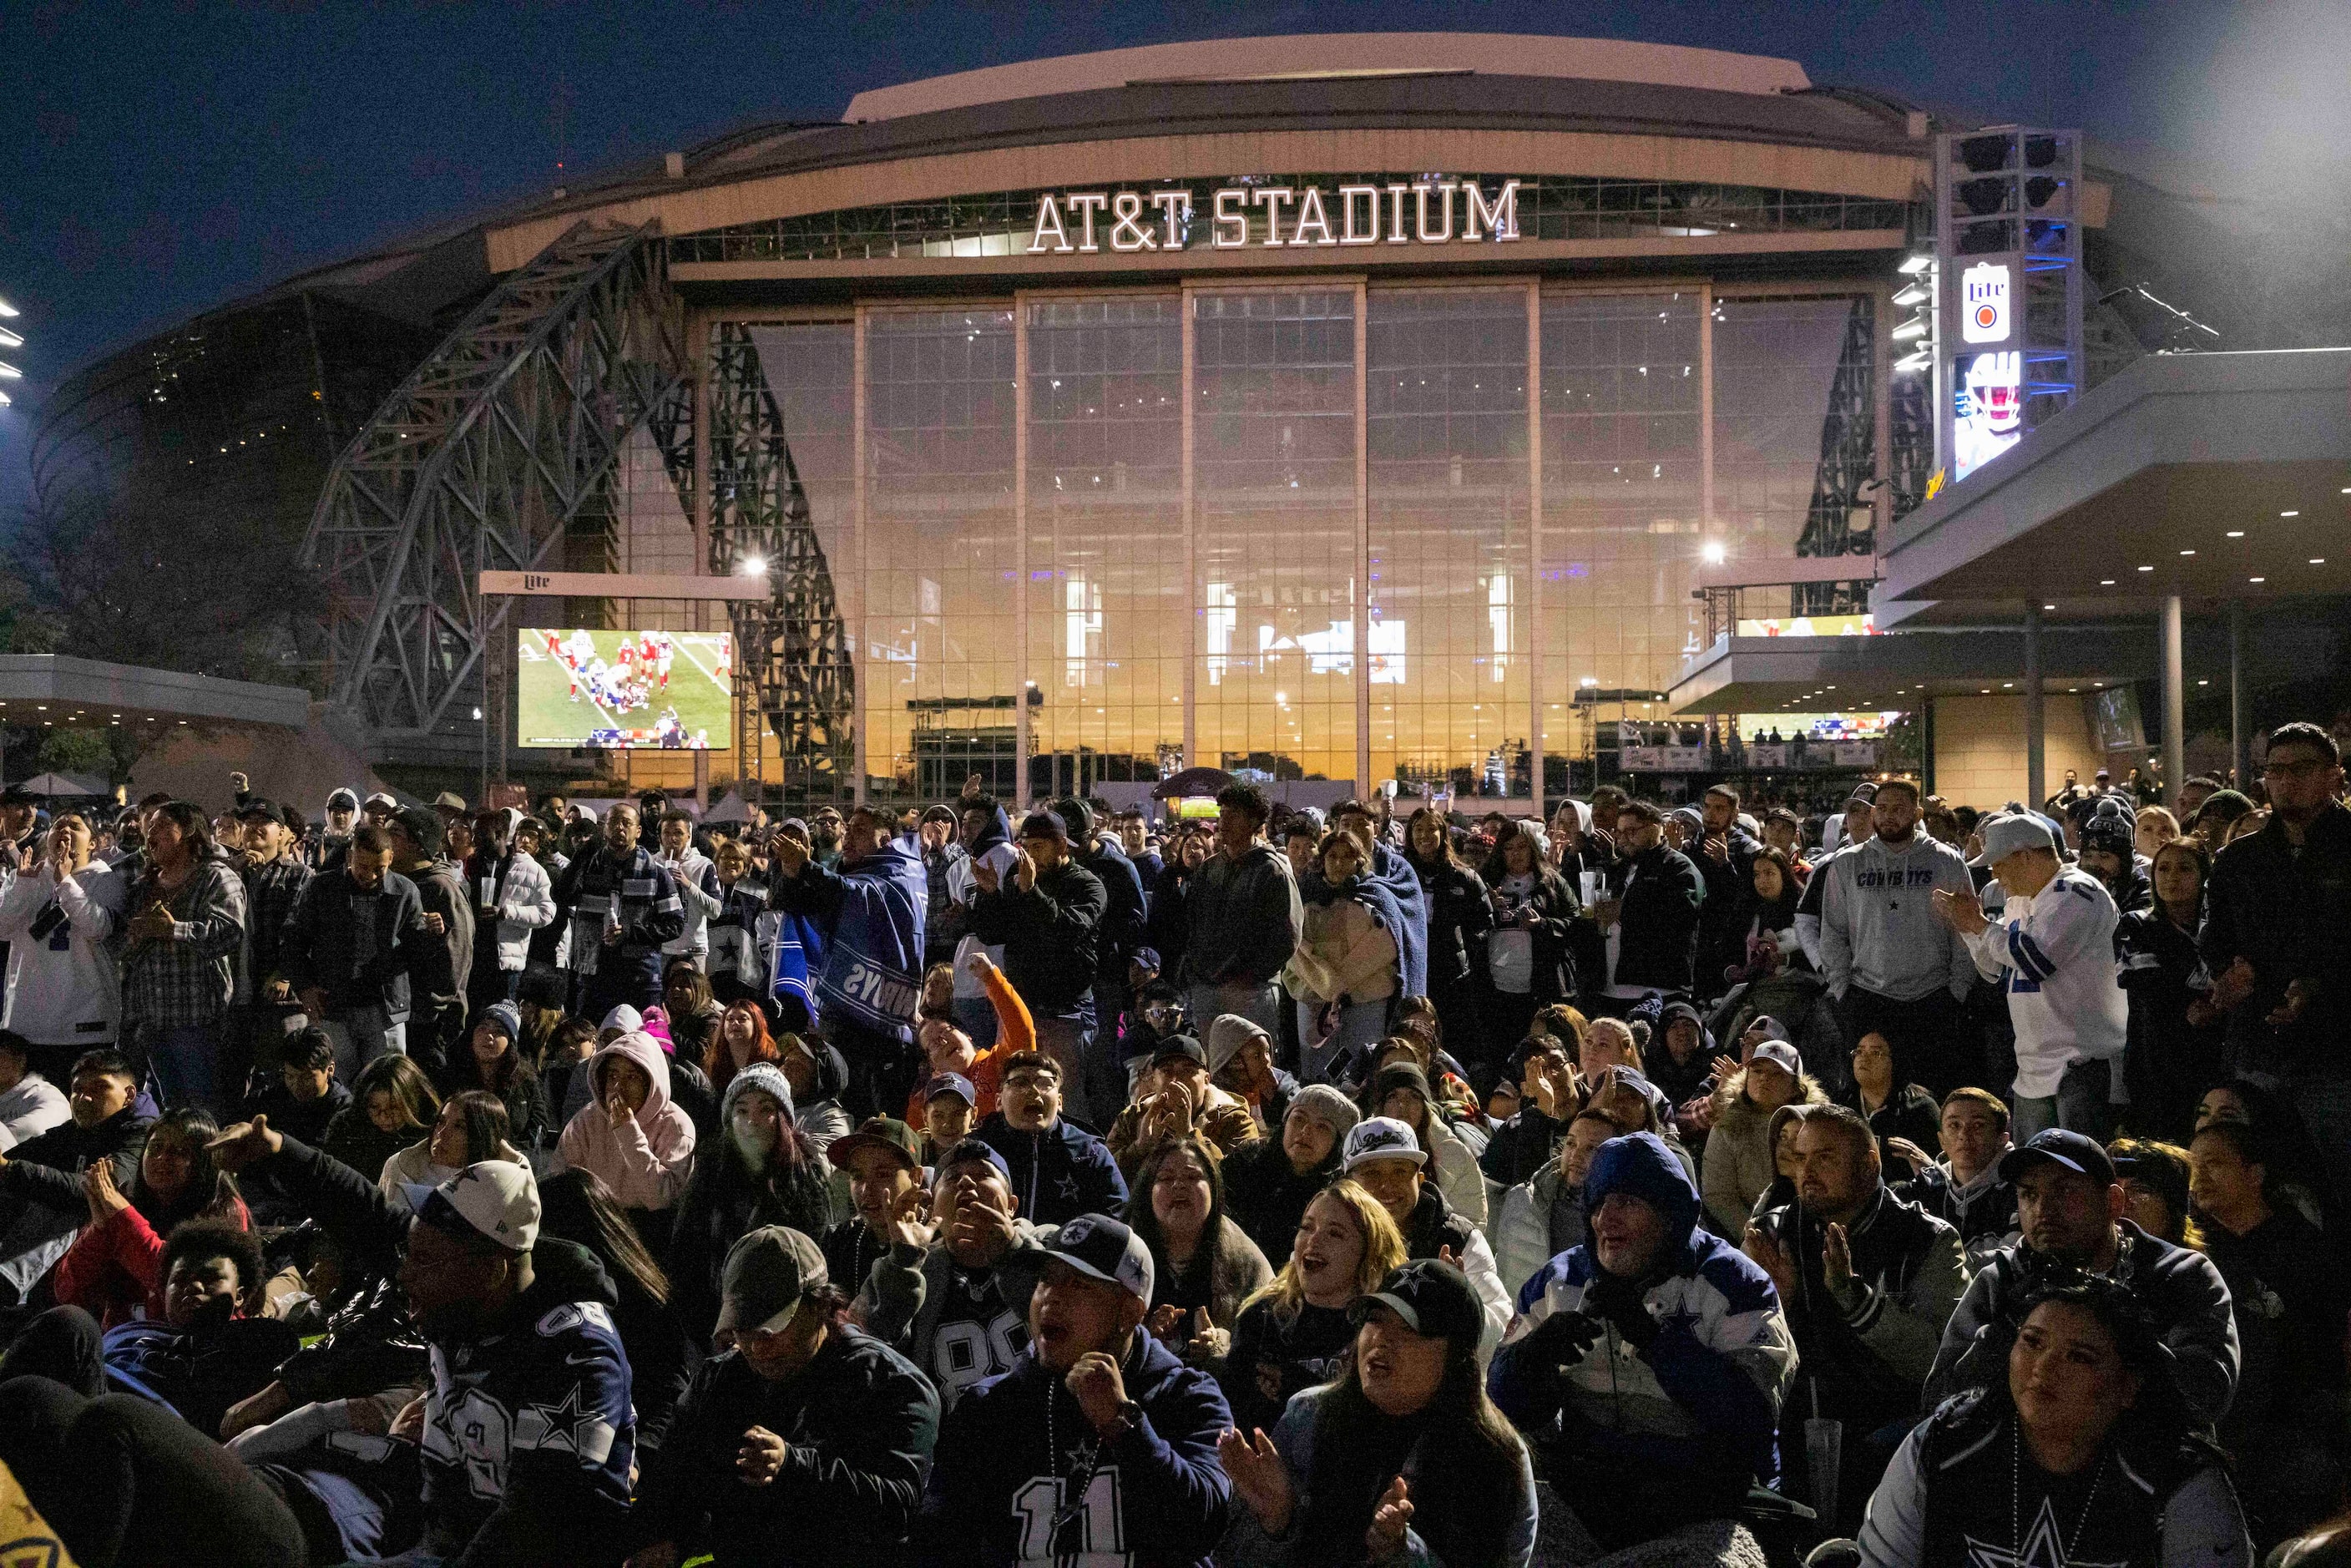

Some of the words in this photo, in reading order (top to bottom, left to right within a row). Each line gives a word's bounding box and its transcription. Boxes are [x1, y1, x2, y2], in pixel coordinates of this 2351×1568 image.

[1026, 192, 1193, 253] AT&T
[1211, 179, 1522, 250] STADIUM
[523, 574, 550, 590] Lite
[1010, 1464, 1135, 1568] 11
